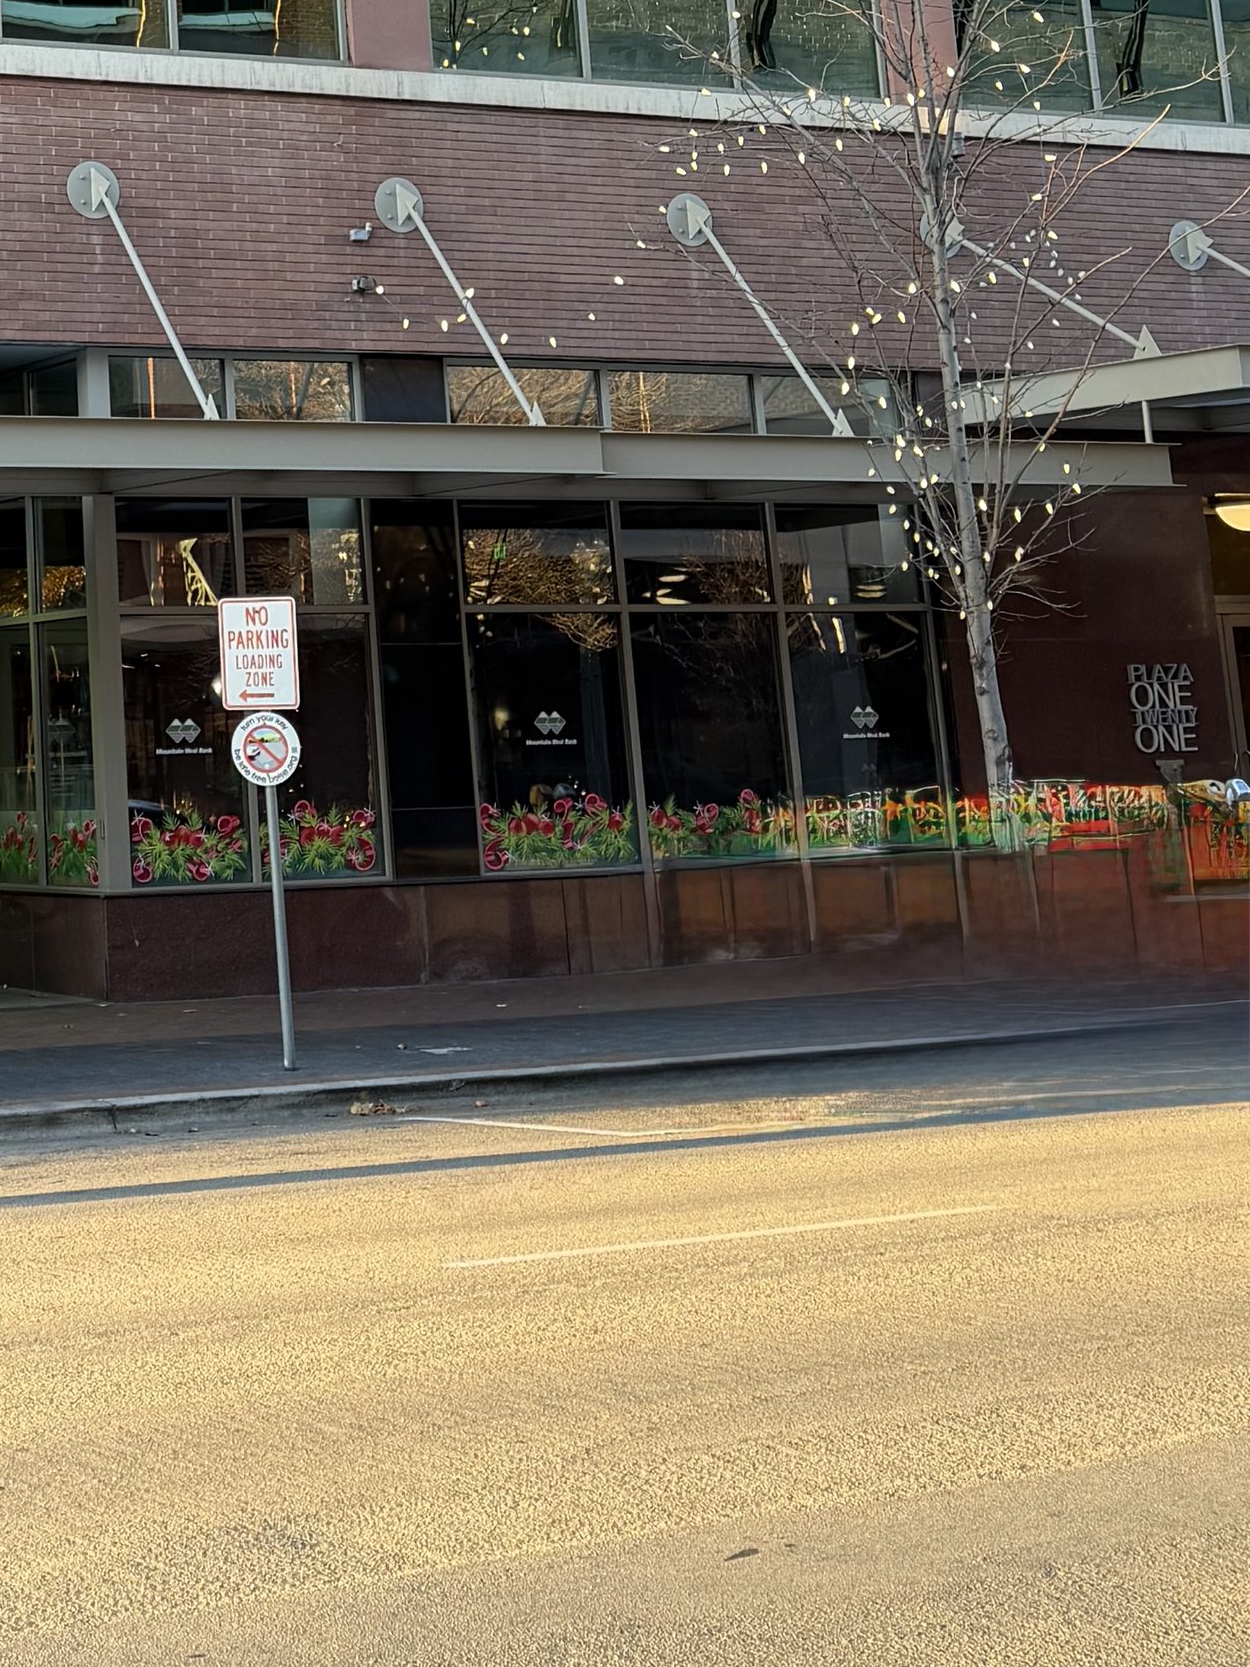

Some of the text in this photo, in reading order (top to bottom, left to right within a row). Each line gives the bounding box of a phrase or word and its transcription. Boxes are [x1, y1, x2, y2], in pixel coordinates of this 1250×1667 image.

[245, 606, 269, 626] NO
[227, 629, 289, 650] PARKING
[235, 654, 283, 670] LOADING
[245, 672, 275, 687] ZONE
[1127, 663, 1194, 684] PLAZA
[1130, 681, 1194, 710] ONE
[1132, 707, 1198, 726] TWENTY
[1135, 723, 1198, 753] ONE
